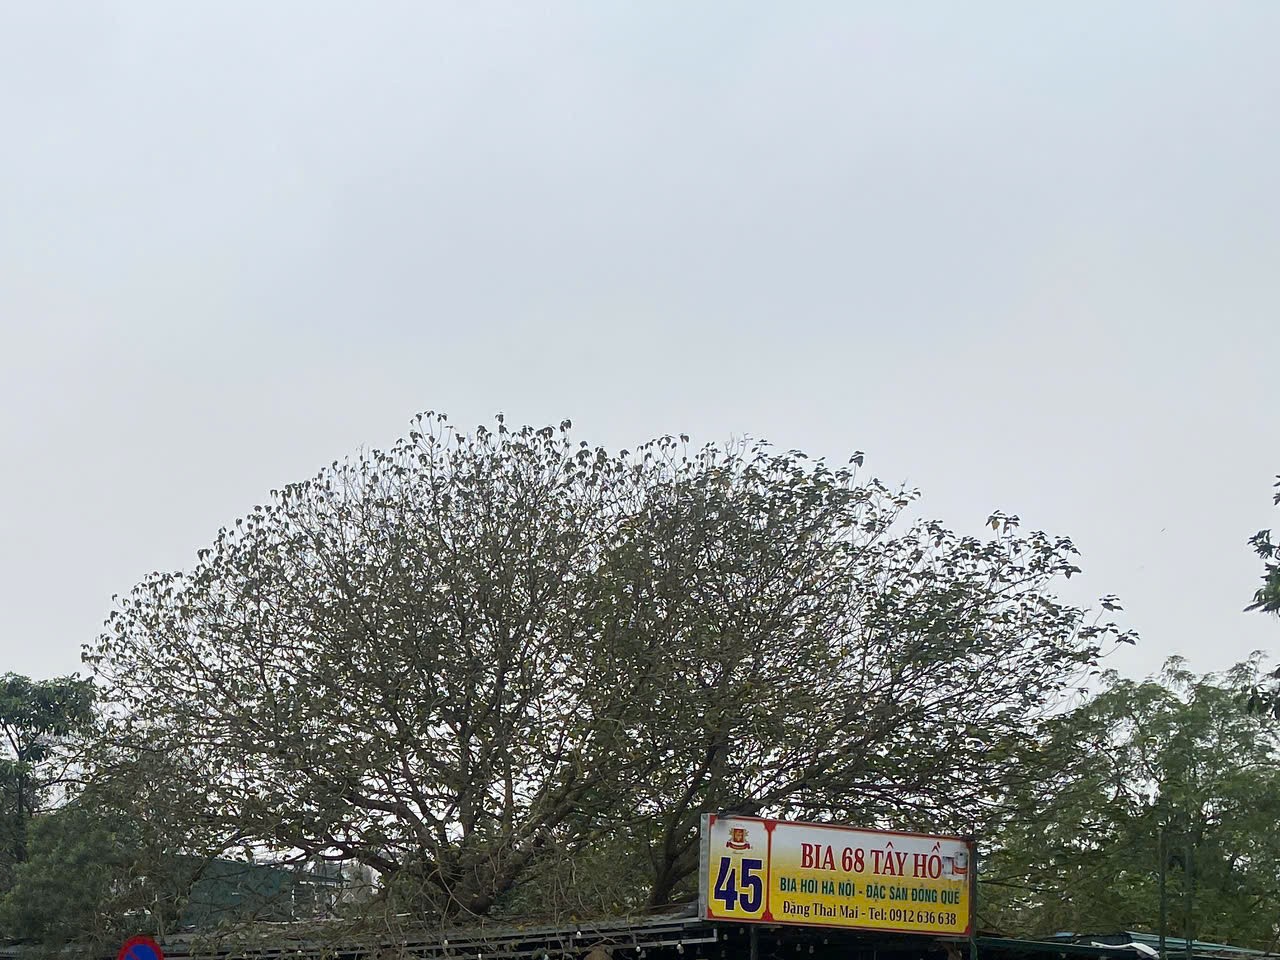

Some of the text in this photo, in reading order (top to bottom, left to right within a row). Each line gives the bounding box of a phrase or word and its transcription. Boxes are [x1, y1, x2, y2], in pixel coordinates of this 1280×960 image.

[801, 841, 942, 879] BIA 68 TÂY HỒ
[714, 857, 763, 912] 45
[780, 877, 797, 892] BIA
[838, 879, 855, 900] NỘI
[866, 882, 886, 903] ĐẶC
[783, 900, 811, 918] Đặng
[840, 905, 859, 919] Mai
[868, 907, 887, 921] Tel:
[889, 908, 915, 923] 0912
[917, 911, 936, 924] 636
[938, 912, 957, 926] 638
